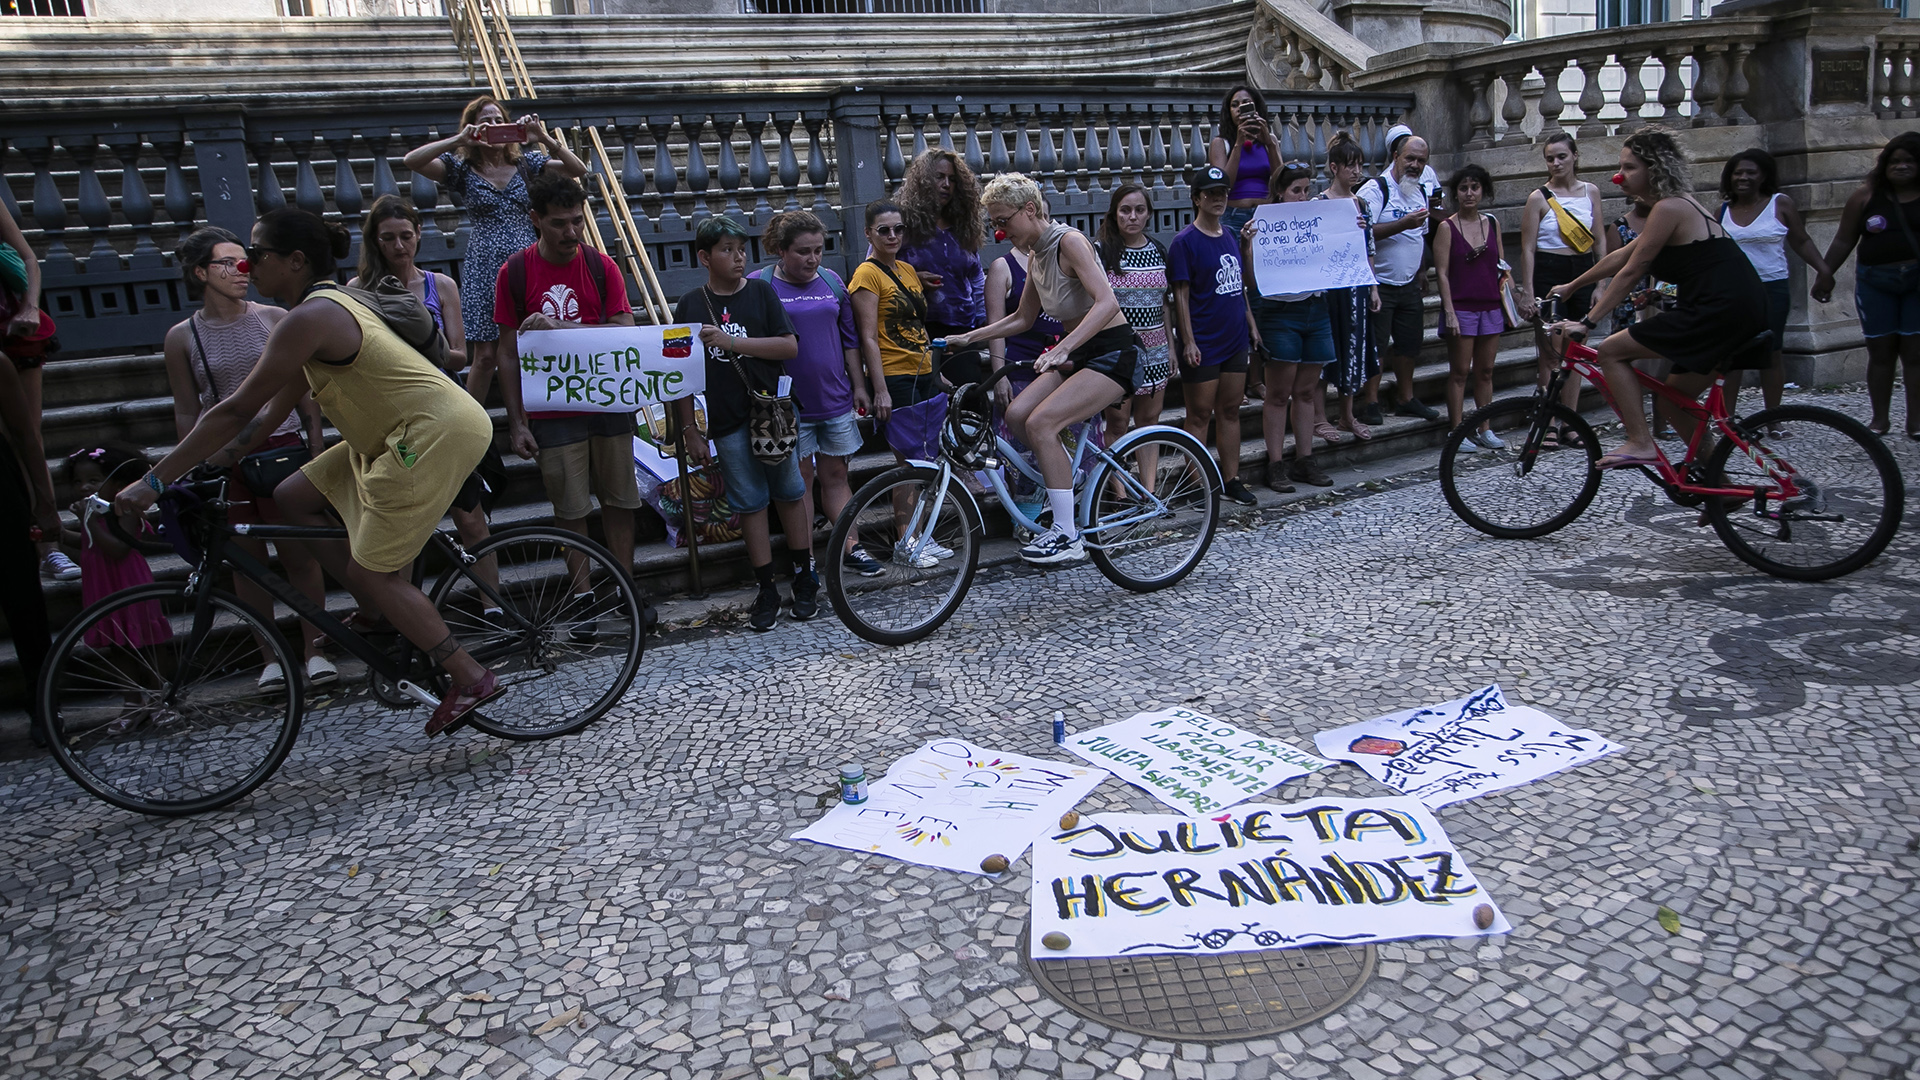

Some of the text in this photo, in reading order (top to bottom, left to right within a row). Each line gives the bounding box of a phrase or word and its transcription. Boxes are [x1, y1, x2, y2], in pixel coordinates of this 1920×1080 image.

[1273, 235, 1290, 245] meu
[1290, 216, 1322, 235] chegar
[520, 346, 641, 376] #JULIETA
[1140, 733, 1269, 794] LIBREMENTE
[1149, 719, 1275, 774] A PEDALAR
[1240, 740, 1325, 772] DERECHO
[1497, 730, 1593, 767] Miss
[1077, 736, 1223, 814] JULIETA SIEMPRE
[1169, 765, 1214, 788] POR
[1051, 803, 1429, 860] JULIETA
[1051, 848, 1479, 920] HERNÁNDEZ
